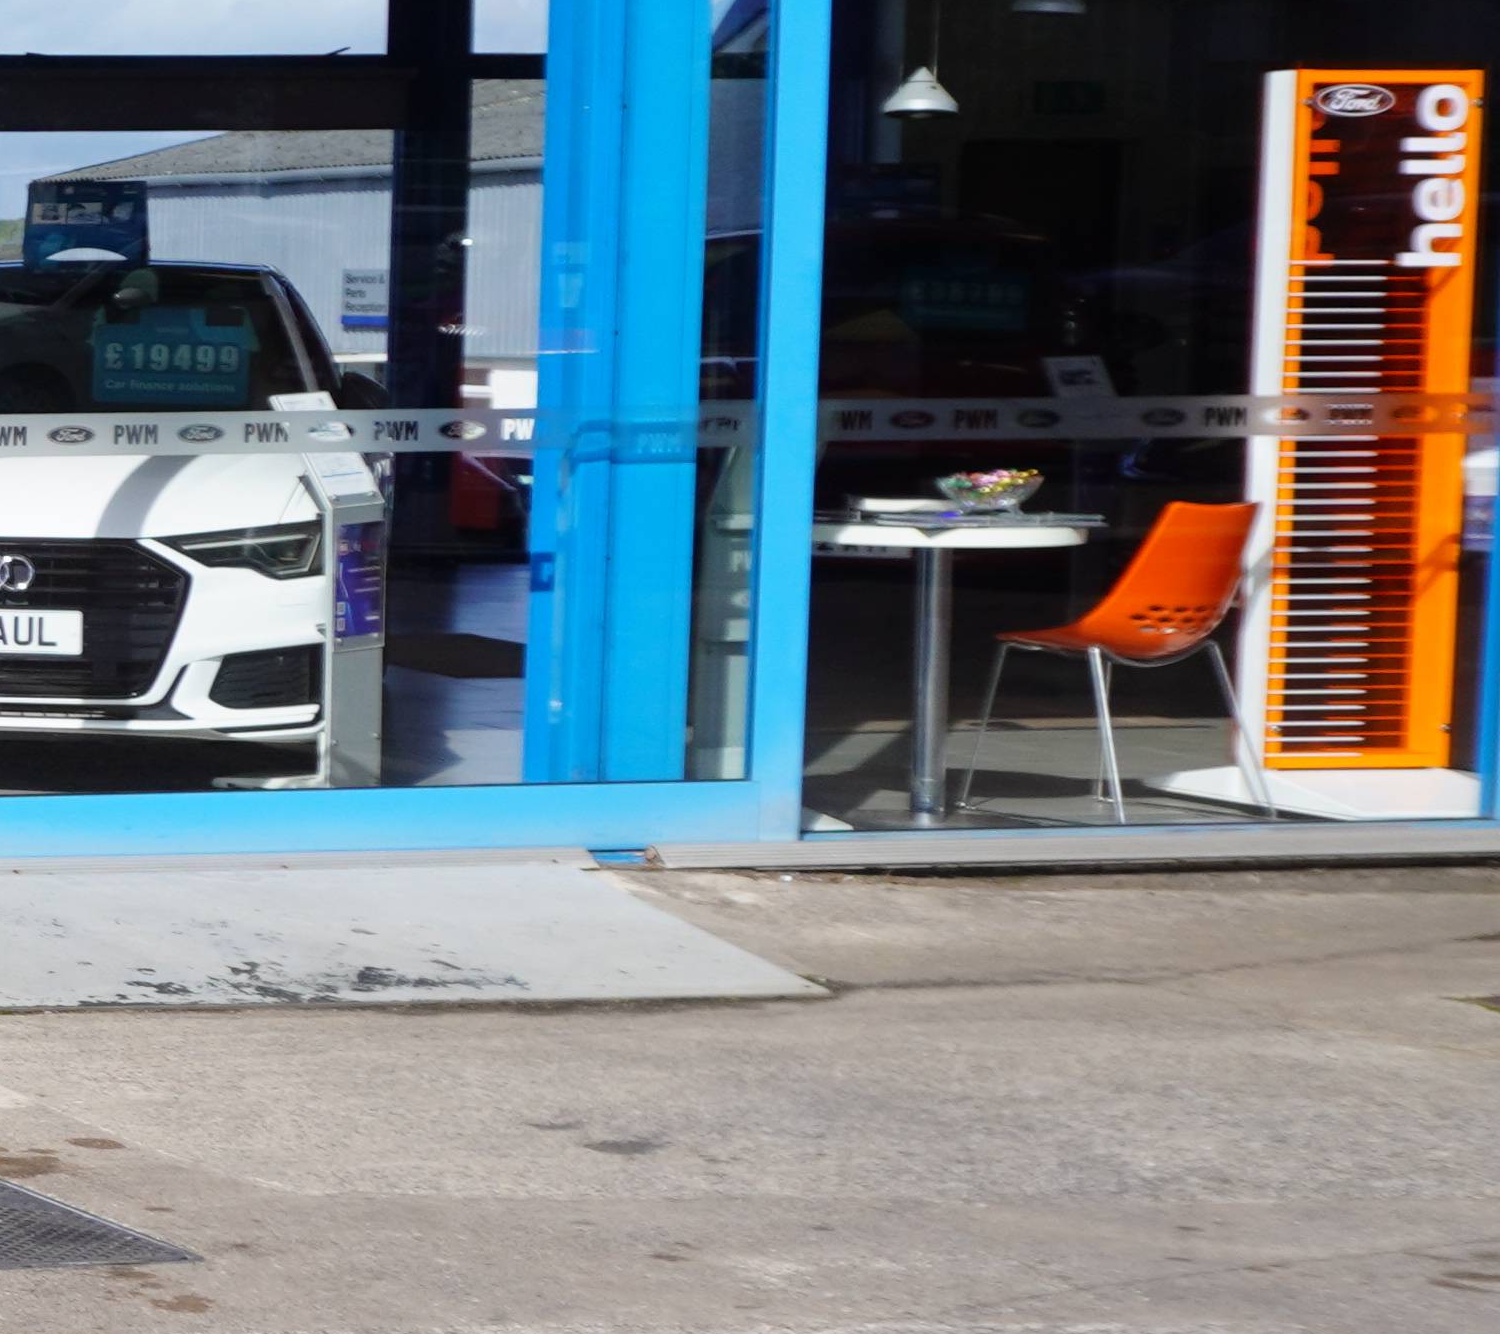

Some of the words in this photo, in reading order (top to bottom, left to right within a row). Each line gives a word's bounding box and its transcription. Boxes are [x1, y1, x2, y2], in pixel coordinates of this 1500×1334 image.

[1395, 84, 1469, 267] hello
[113, 424, 159, 444] PWM
[374, 420, 419, 441] PWM
